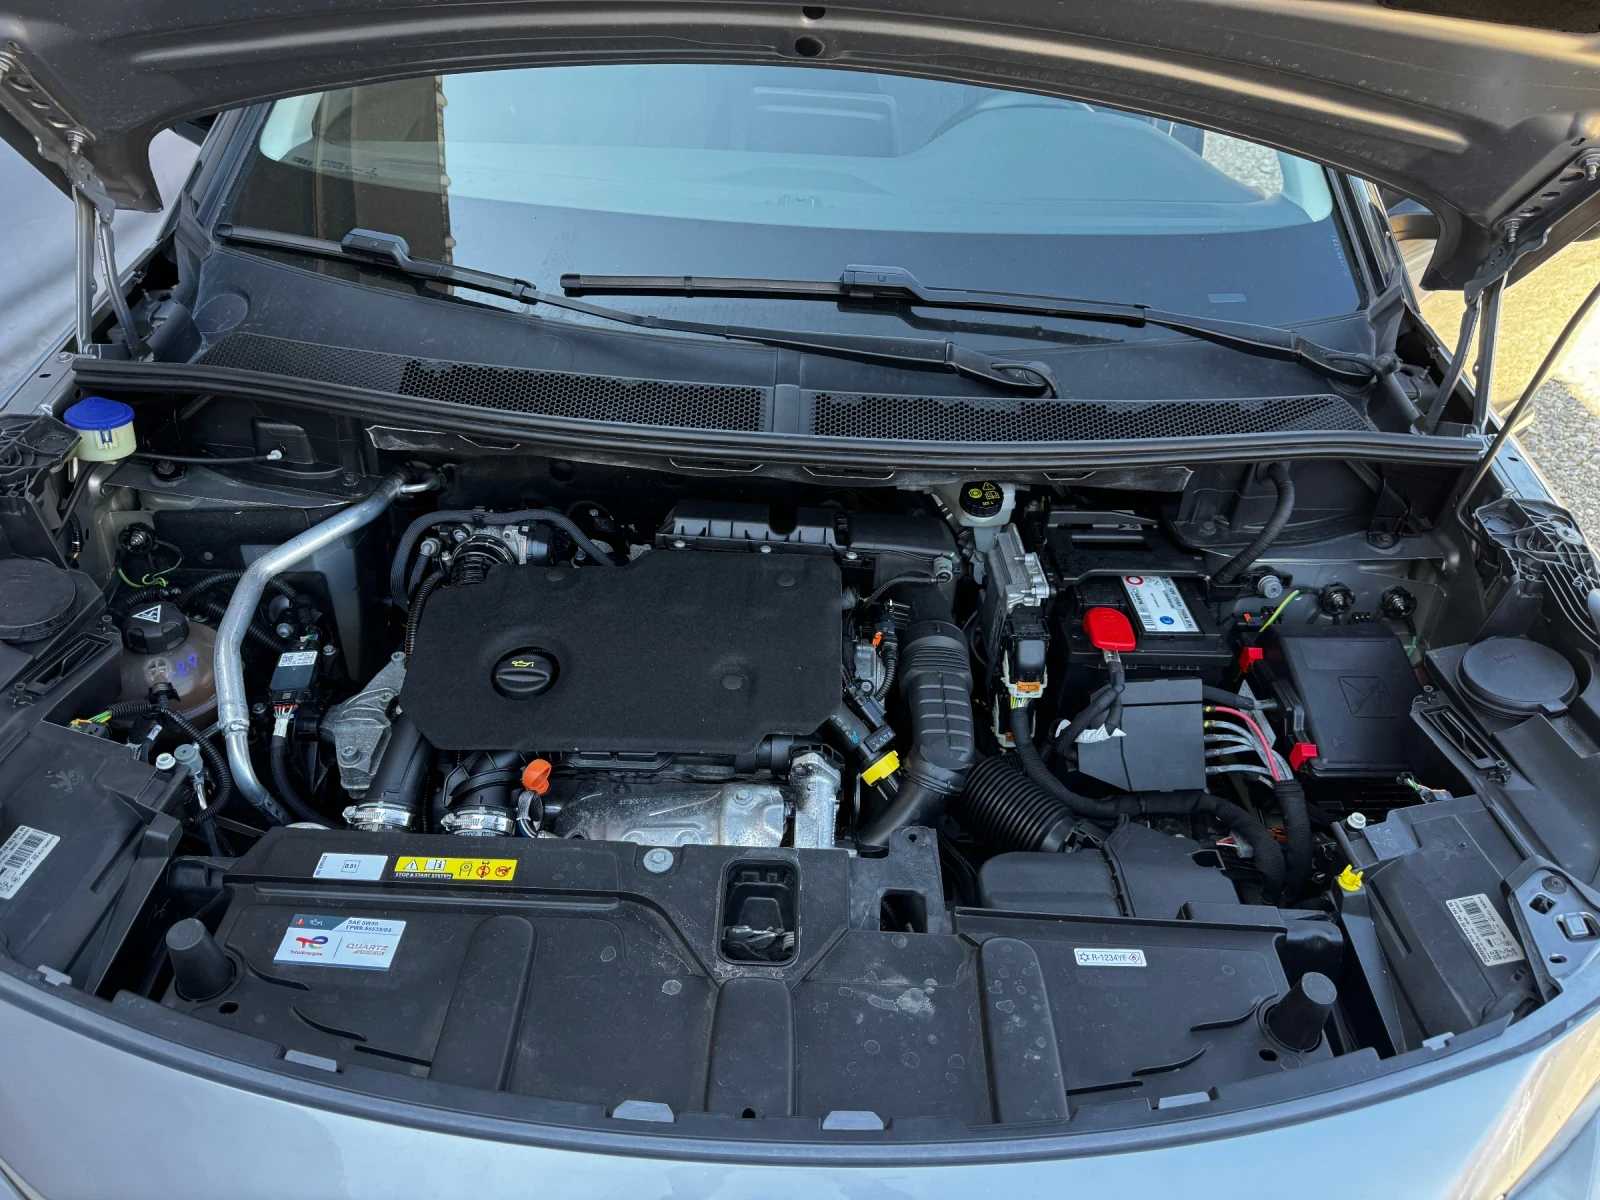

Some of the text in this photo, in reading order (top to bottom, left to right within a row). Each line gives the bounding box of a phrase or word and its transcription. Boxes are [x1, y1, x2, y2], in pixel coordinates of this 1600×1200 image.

[346, 943, 388, 951] QUARTZ
[289, 949, 322, 957] TotalEnergies
[1091, 953, 1127, 961] R-1234YF
